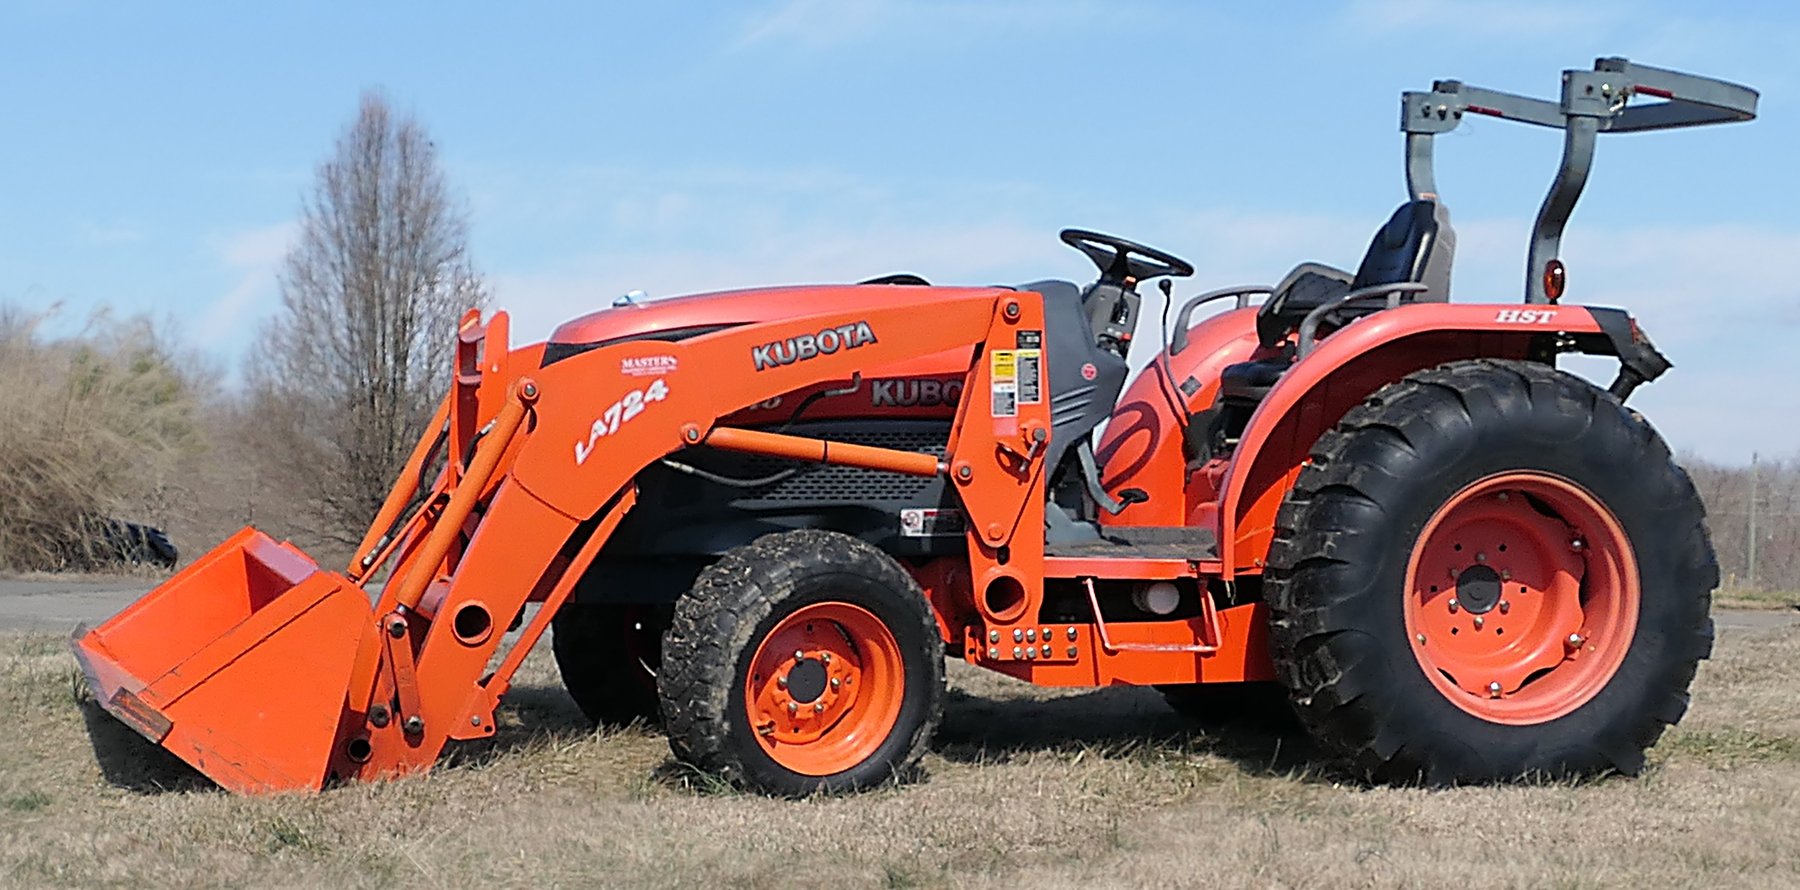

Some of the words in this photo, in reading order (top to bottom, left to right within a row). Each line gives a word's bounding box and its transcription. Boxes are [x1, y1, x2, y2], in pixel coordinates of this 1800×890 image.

[1496, 309, 1558, 325] HST
[752, 320, 878, 371] KUBOTA
[575, 379, 670, 465] LA724
